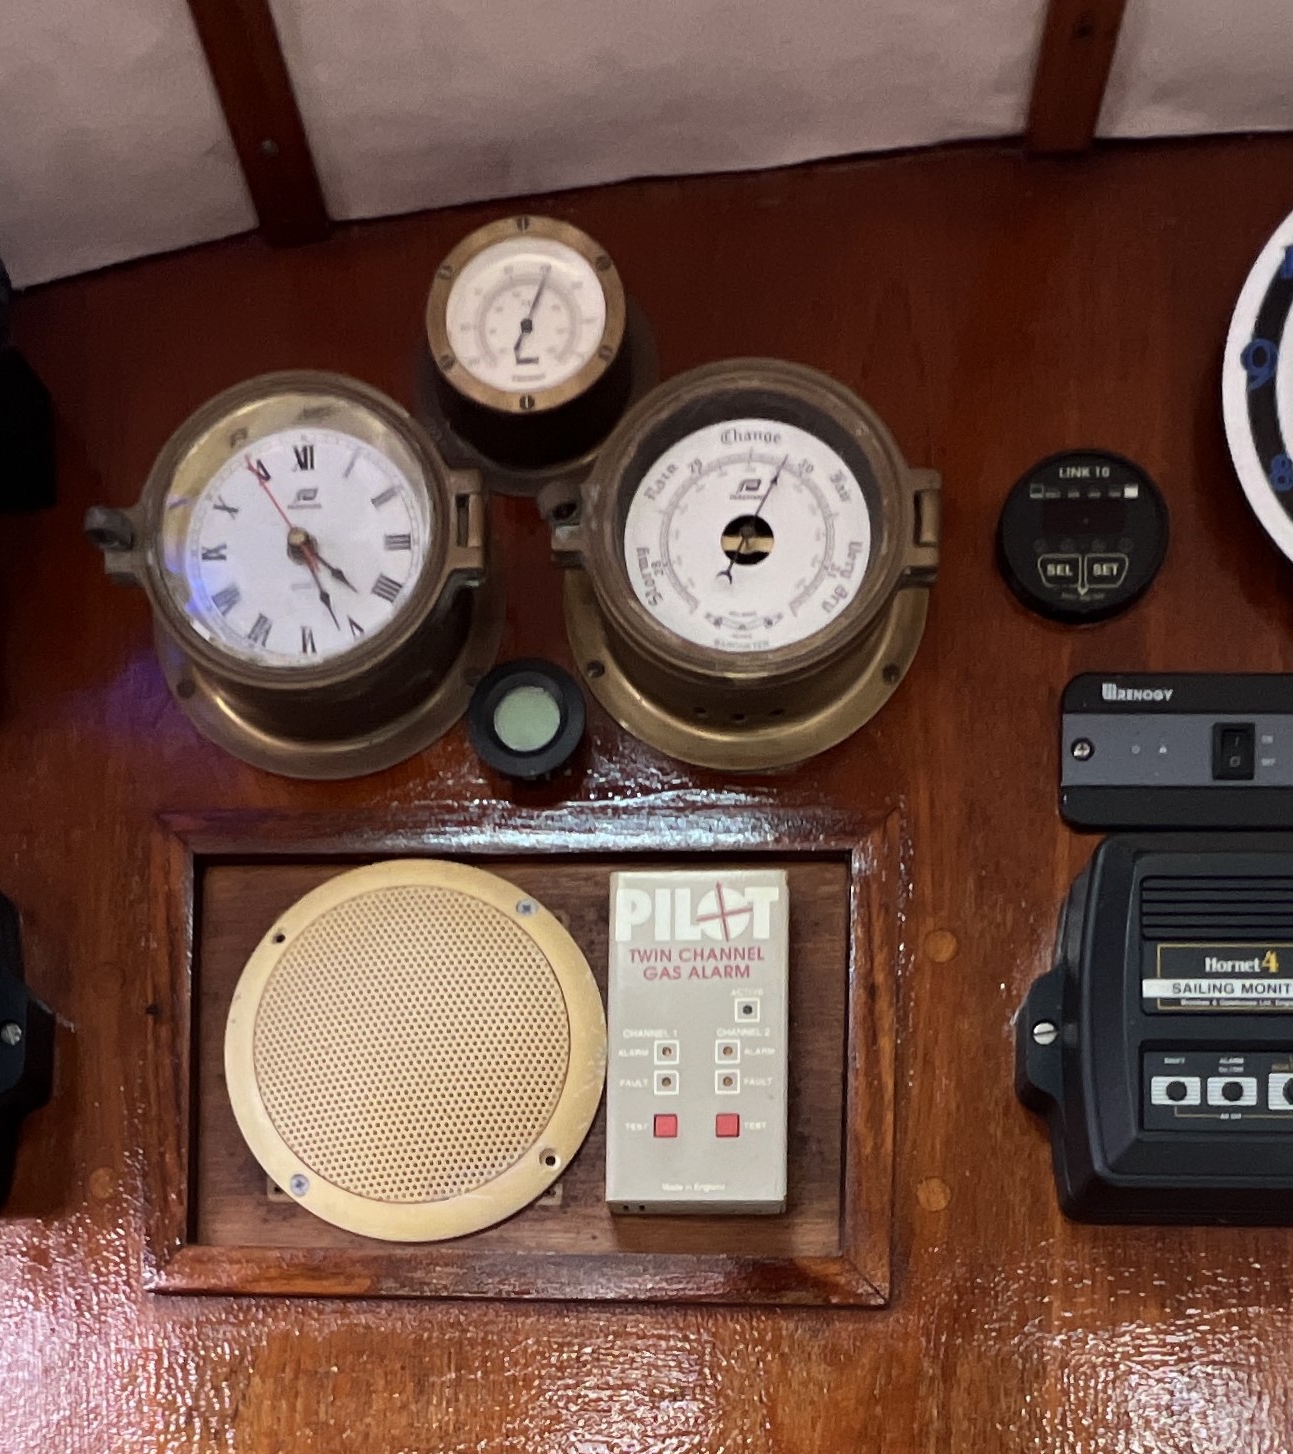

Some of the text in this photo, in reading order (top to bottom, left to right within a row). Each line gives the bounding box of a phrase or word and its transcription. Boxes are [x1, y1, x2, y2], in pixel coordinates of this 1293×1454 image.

[1240, 338, 1277, 390] 9
[720, 429, 781, 444] Change
[1059, 466, 1110, 478] LINK 10
[644, 463, 678, 500] Rain
[1046, 564, 1073, 576] SEL
[1093, 563, 1119, 576] SET
[1115, 688, 1174, 701] RENOGY
[615, 886, 780, 941] PILOT
[630, 947, 765, 963] TWIN CHANNEL
[1205, 950, 1280, 973] Hornet 4
[643, 964, 751, 980] GAS ALARM
[1172, 983, 1235, 994] SAILING
[622, 1028, 669, 1039] CHANNEL
[716, 1027, 761, 1038] CHANNEL
[618, 1049, 649, 1057] ALARM
[744, 1047, 776, 1056] ALARM
[619, 1079, 649, 1088] FAULT
[744, 1078, 773, 1087] FAULT
[625, 1123, 649, 1131] TEST
[744, 1121, 767, 1130] TEST
